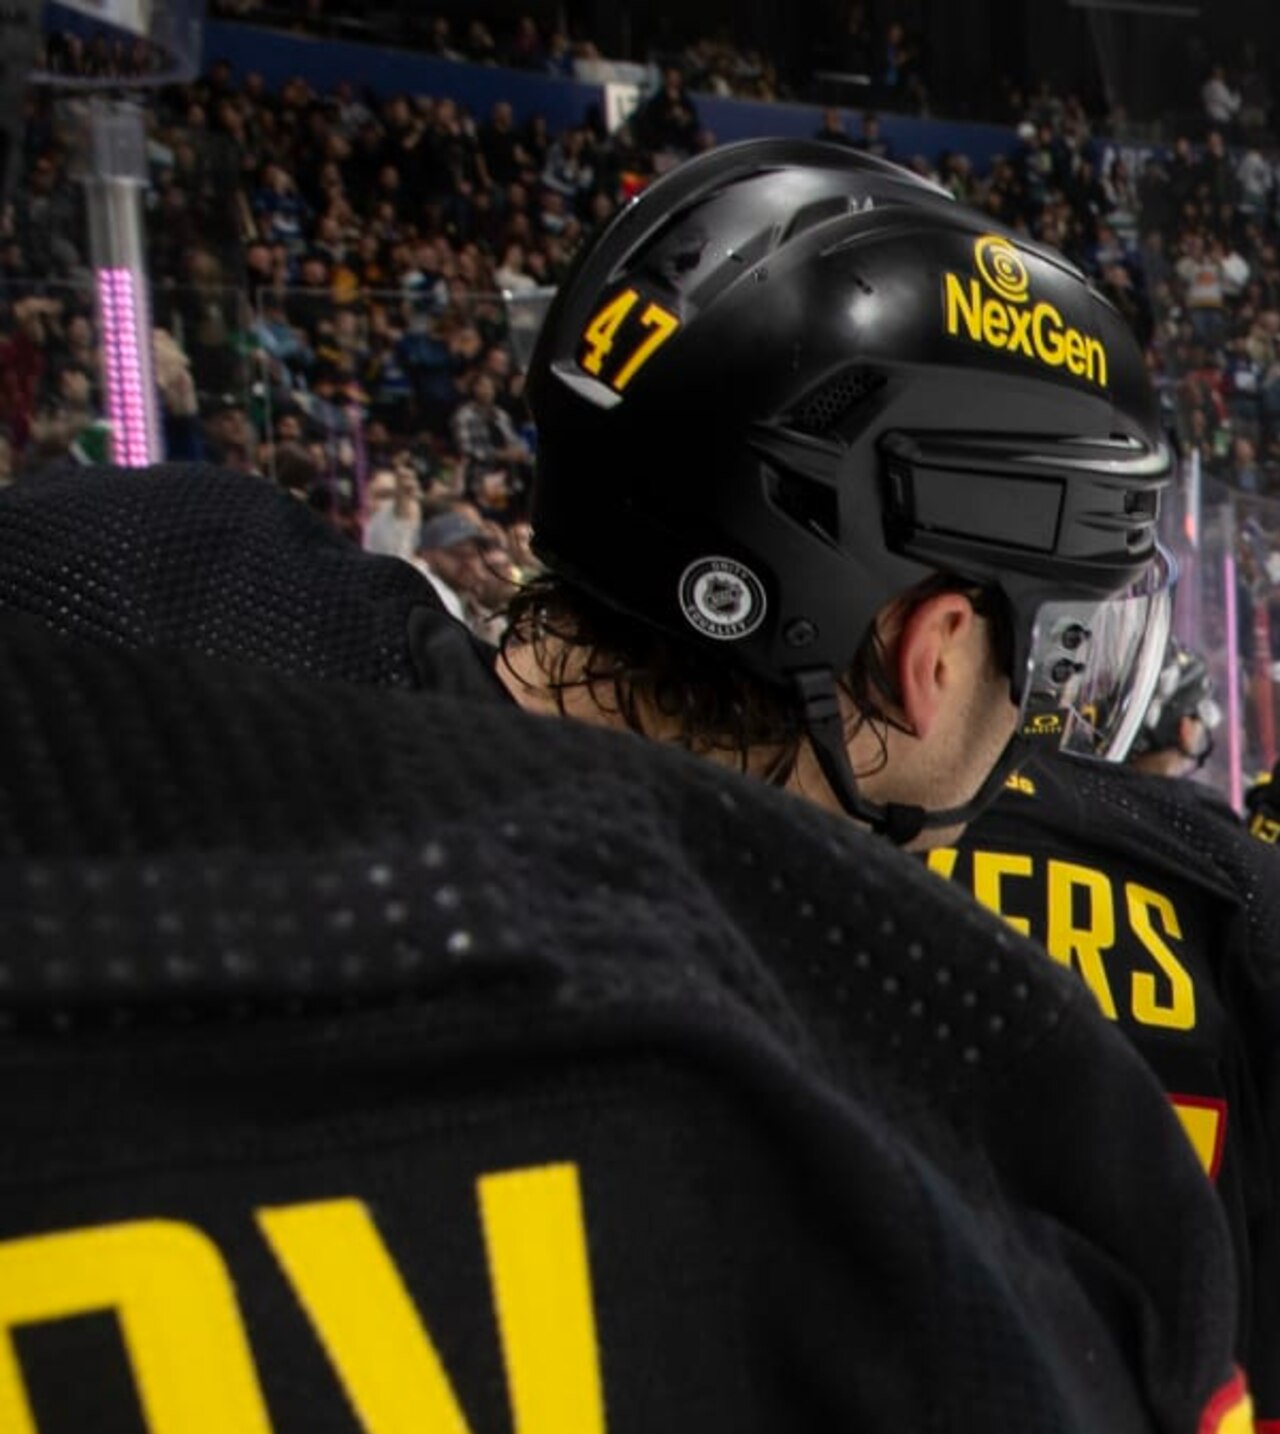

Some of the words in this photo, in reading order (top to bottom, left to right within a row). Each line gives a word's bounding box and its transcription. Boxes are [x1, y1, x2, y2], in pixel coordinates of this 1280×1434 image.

[580, 287, 681, 396] 47
[944, 271, 1108, 388] NexGen
[927, 847, 1197, 1032] ERS
